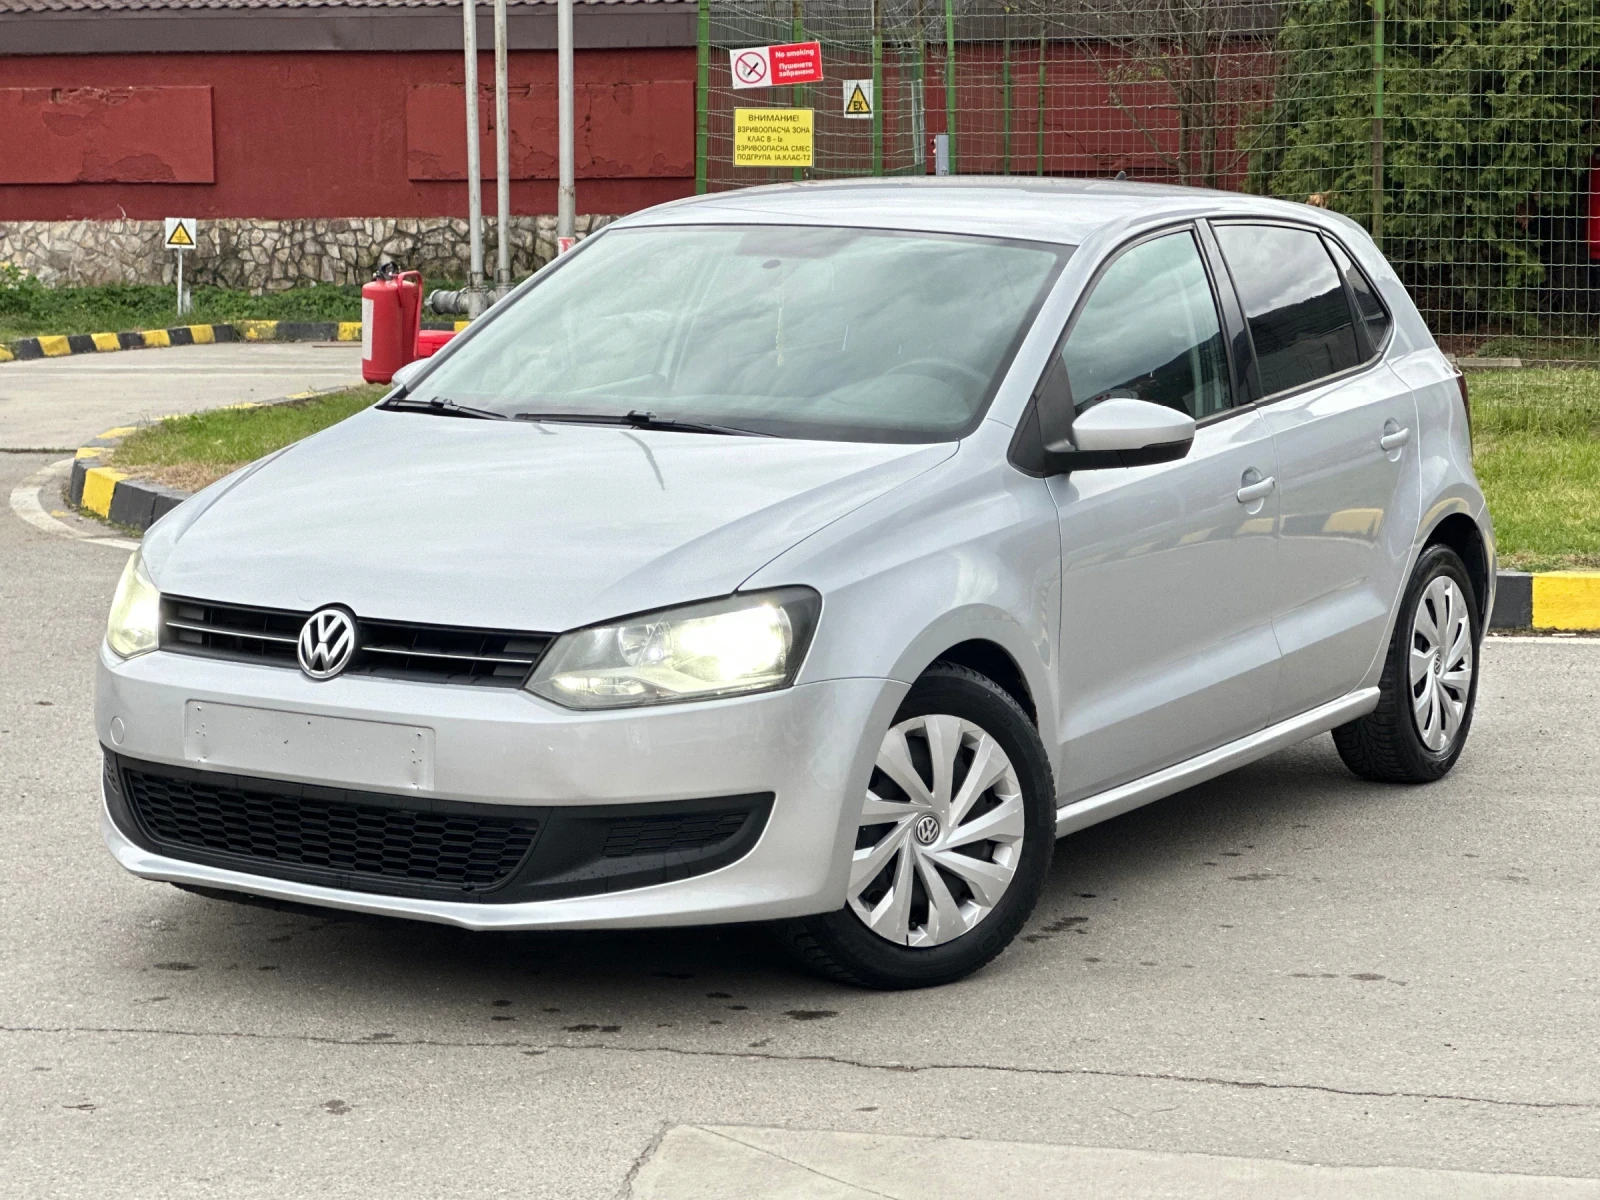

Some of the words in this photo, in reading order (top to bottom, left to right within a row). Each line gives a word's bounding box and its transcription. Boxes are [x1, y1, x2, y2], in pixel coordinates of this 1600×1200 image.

[786, 48, 815, 56] smoking
[779, 62, 813, 70] Пушенето
[779, 69, 815, 77] забранено
[853, 101, 863, 110] EX
[748, 114, 799, 122] ВНИМАНИЕ!
[792, 126, 810, 134] ЗОНА
